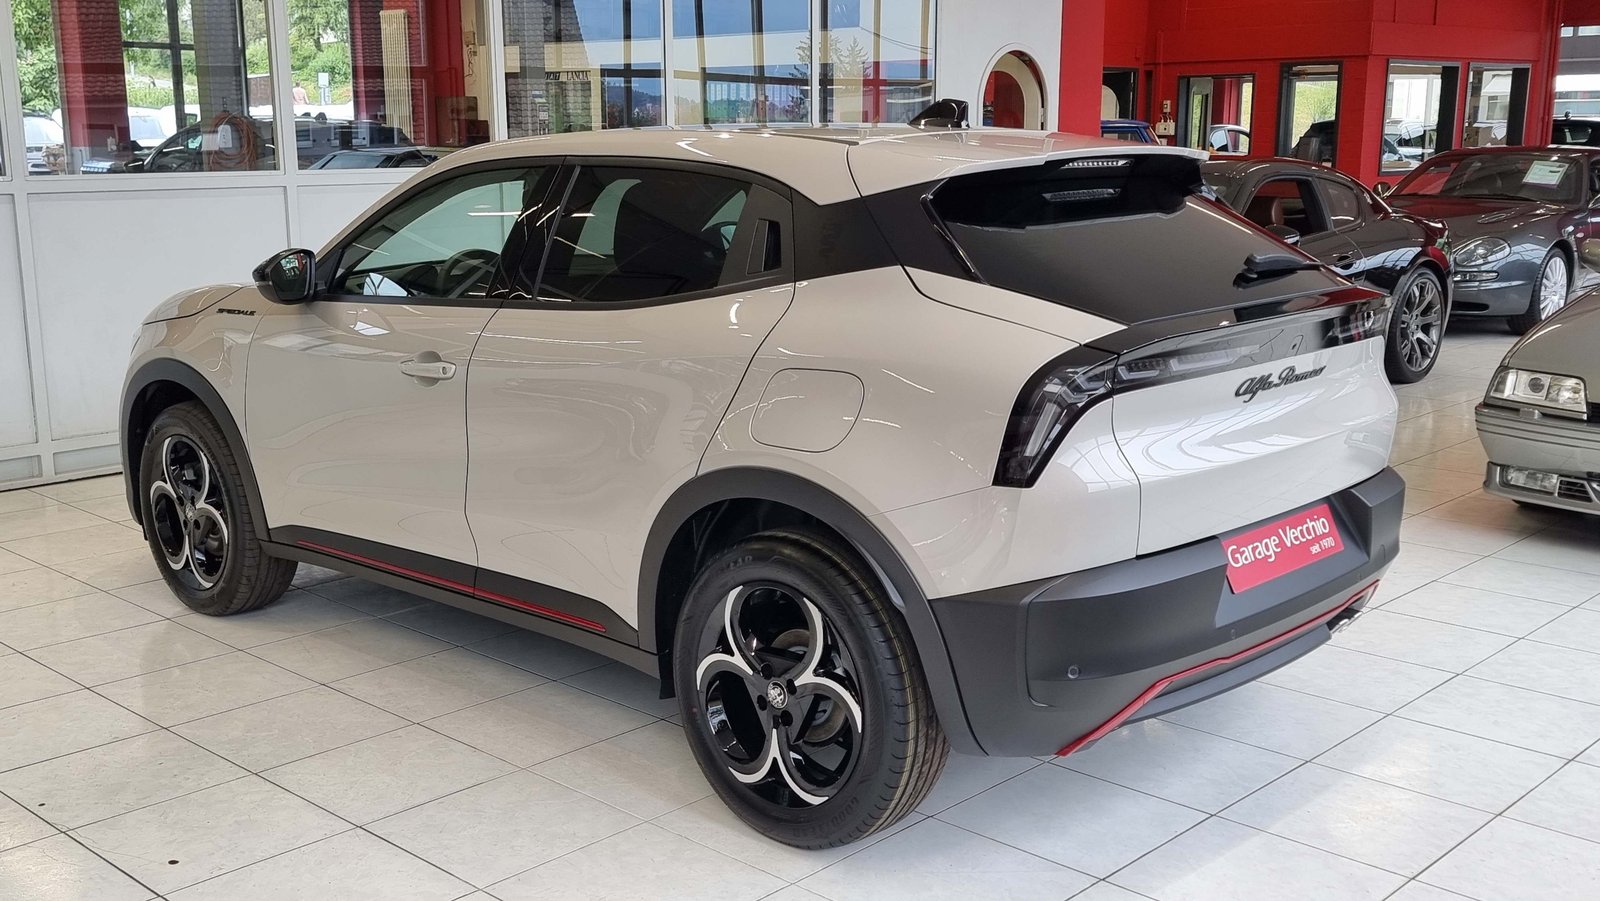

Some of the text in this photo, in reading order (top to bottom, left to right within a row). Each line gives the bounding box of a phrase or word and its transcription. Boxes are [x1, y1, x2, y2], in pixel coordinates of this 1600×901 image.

[566, 71, 590, 81] LANCIA
[216, 308, 257, 317] SPECIALE
[1235, 365, 1328, 403] Alfa Romeo
[1227, 515, 1330, 568] Garage Vecchio
[1309, 536, 1336, 555] seit 1970
